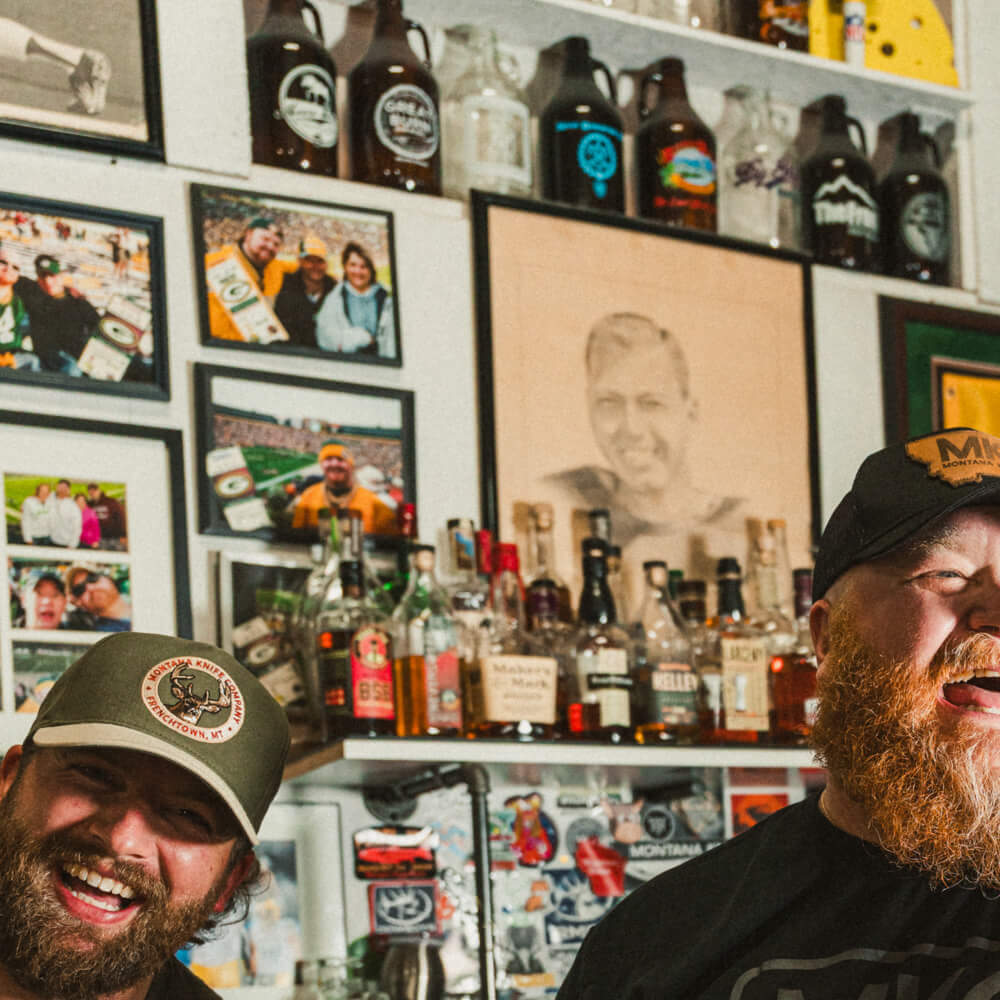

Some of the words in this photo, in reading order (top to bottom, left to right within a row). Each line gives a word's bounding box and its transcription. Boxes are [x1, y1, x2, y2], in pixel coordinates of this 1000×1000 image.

[150, 658, 193, 682] MONTANA
[196, 660, 226, 679] KNIFE
[224, 678, 245, 725] COMPANY
[211, 729, 225, 740] MT
[629, 843, 703, 858] MONTANA
